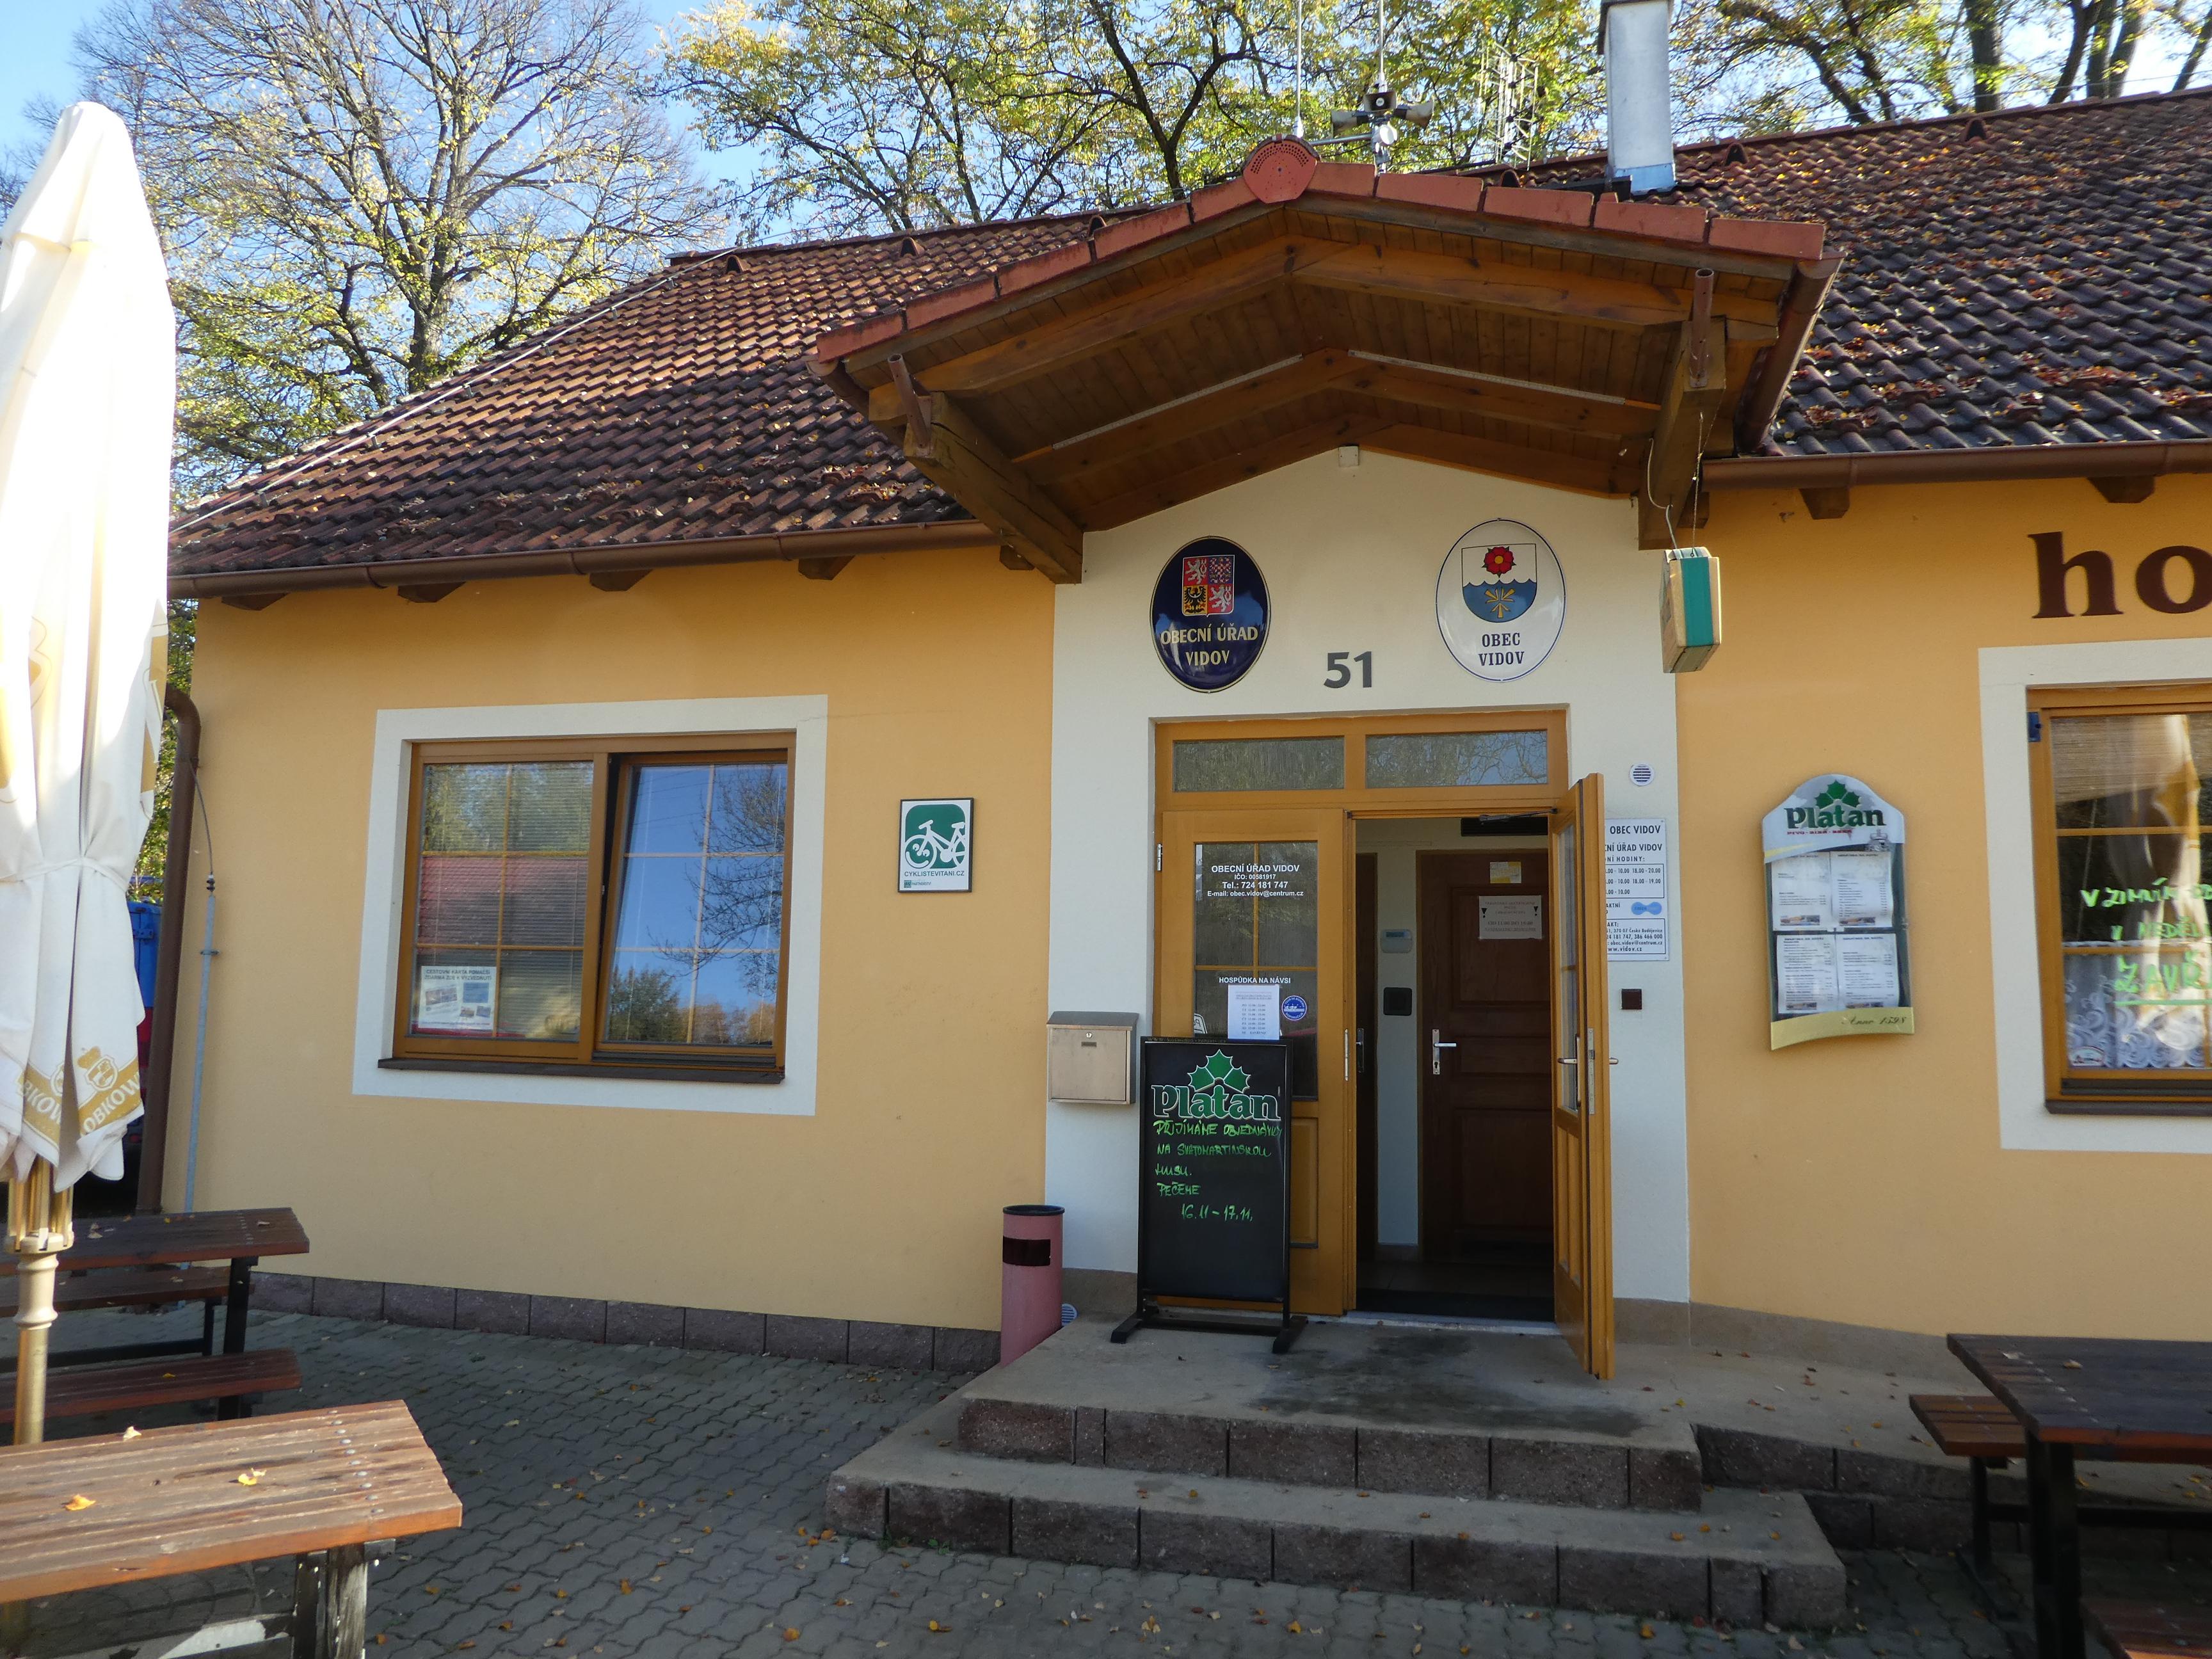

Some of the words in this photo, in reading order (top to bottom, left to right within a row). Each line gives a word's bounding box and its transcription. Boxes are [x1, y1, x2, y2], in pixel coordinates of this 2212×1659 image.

[2027, 531, 2212, 619] ho
[1160, 623, 1212, 645] OBECNÍ
[1217, 623, 1258, 641] ÚŘAD
[1482, 632, 1520, 647] OBEC
[1185, 650, 1230, 666] VIDOV
[1478, 652, 1525, 666] VIDOV
[1324, 652, 1372, 689] 51
[1784, 805, 1887, 829] Platan
[1610, 826, 1631, 834] OBEC
[1633, 825, 1660, 834] VIDOV
[1617, 842, 1637, 852] ÚŘAD
[1212, 863, 1244, 872] OBECNÍ
[1246, 863, 1270, 872] ÚŘAD
[2080, 888, 2100, 908] V
[1151, 1085, 1281, 1121] Platan
[1157, 1143, 1171, 1155] NA
